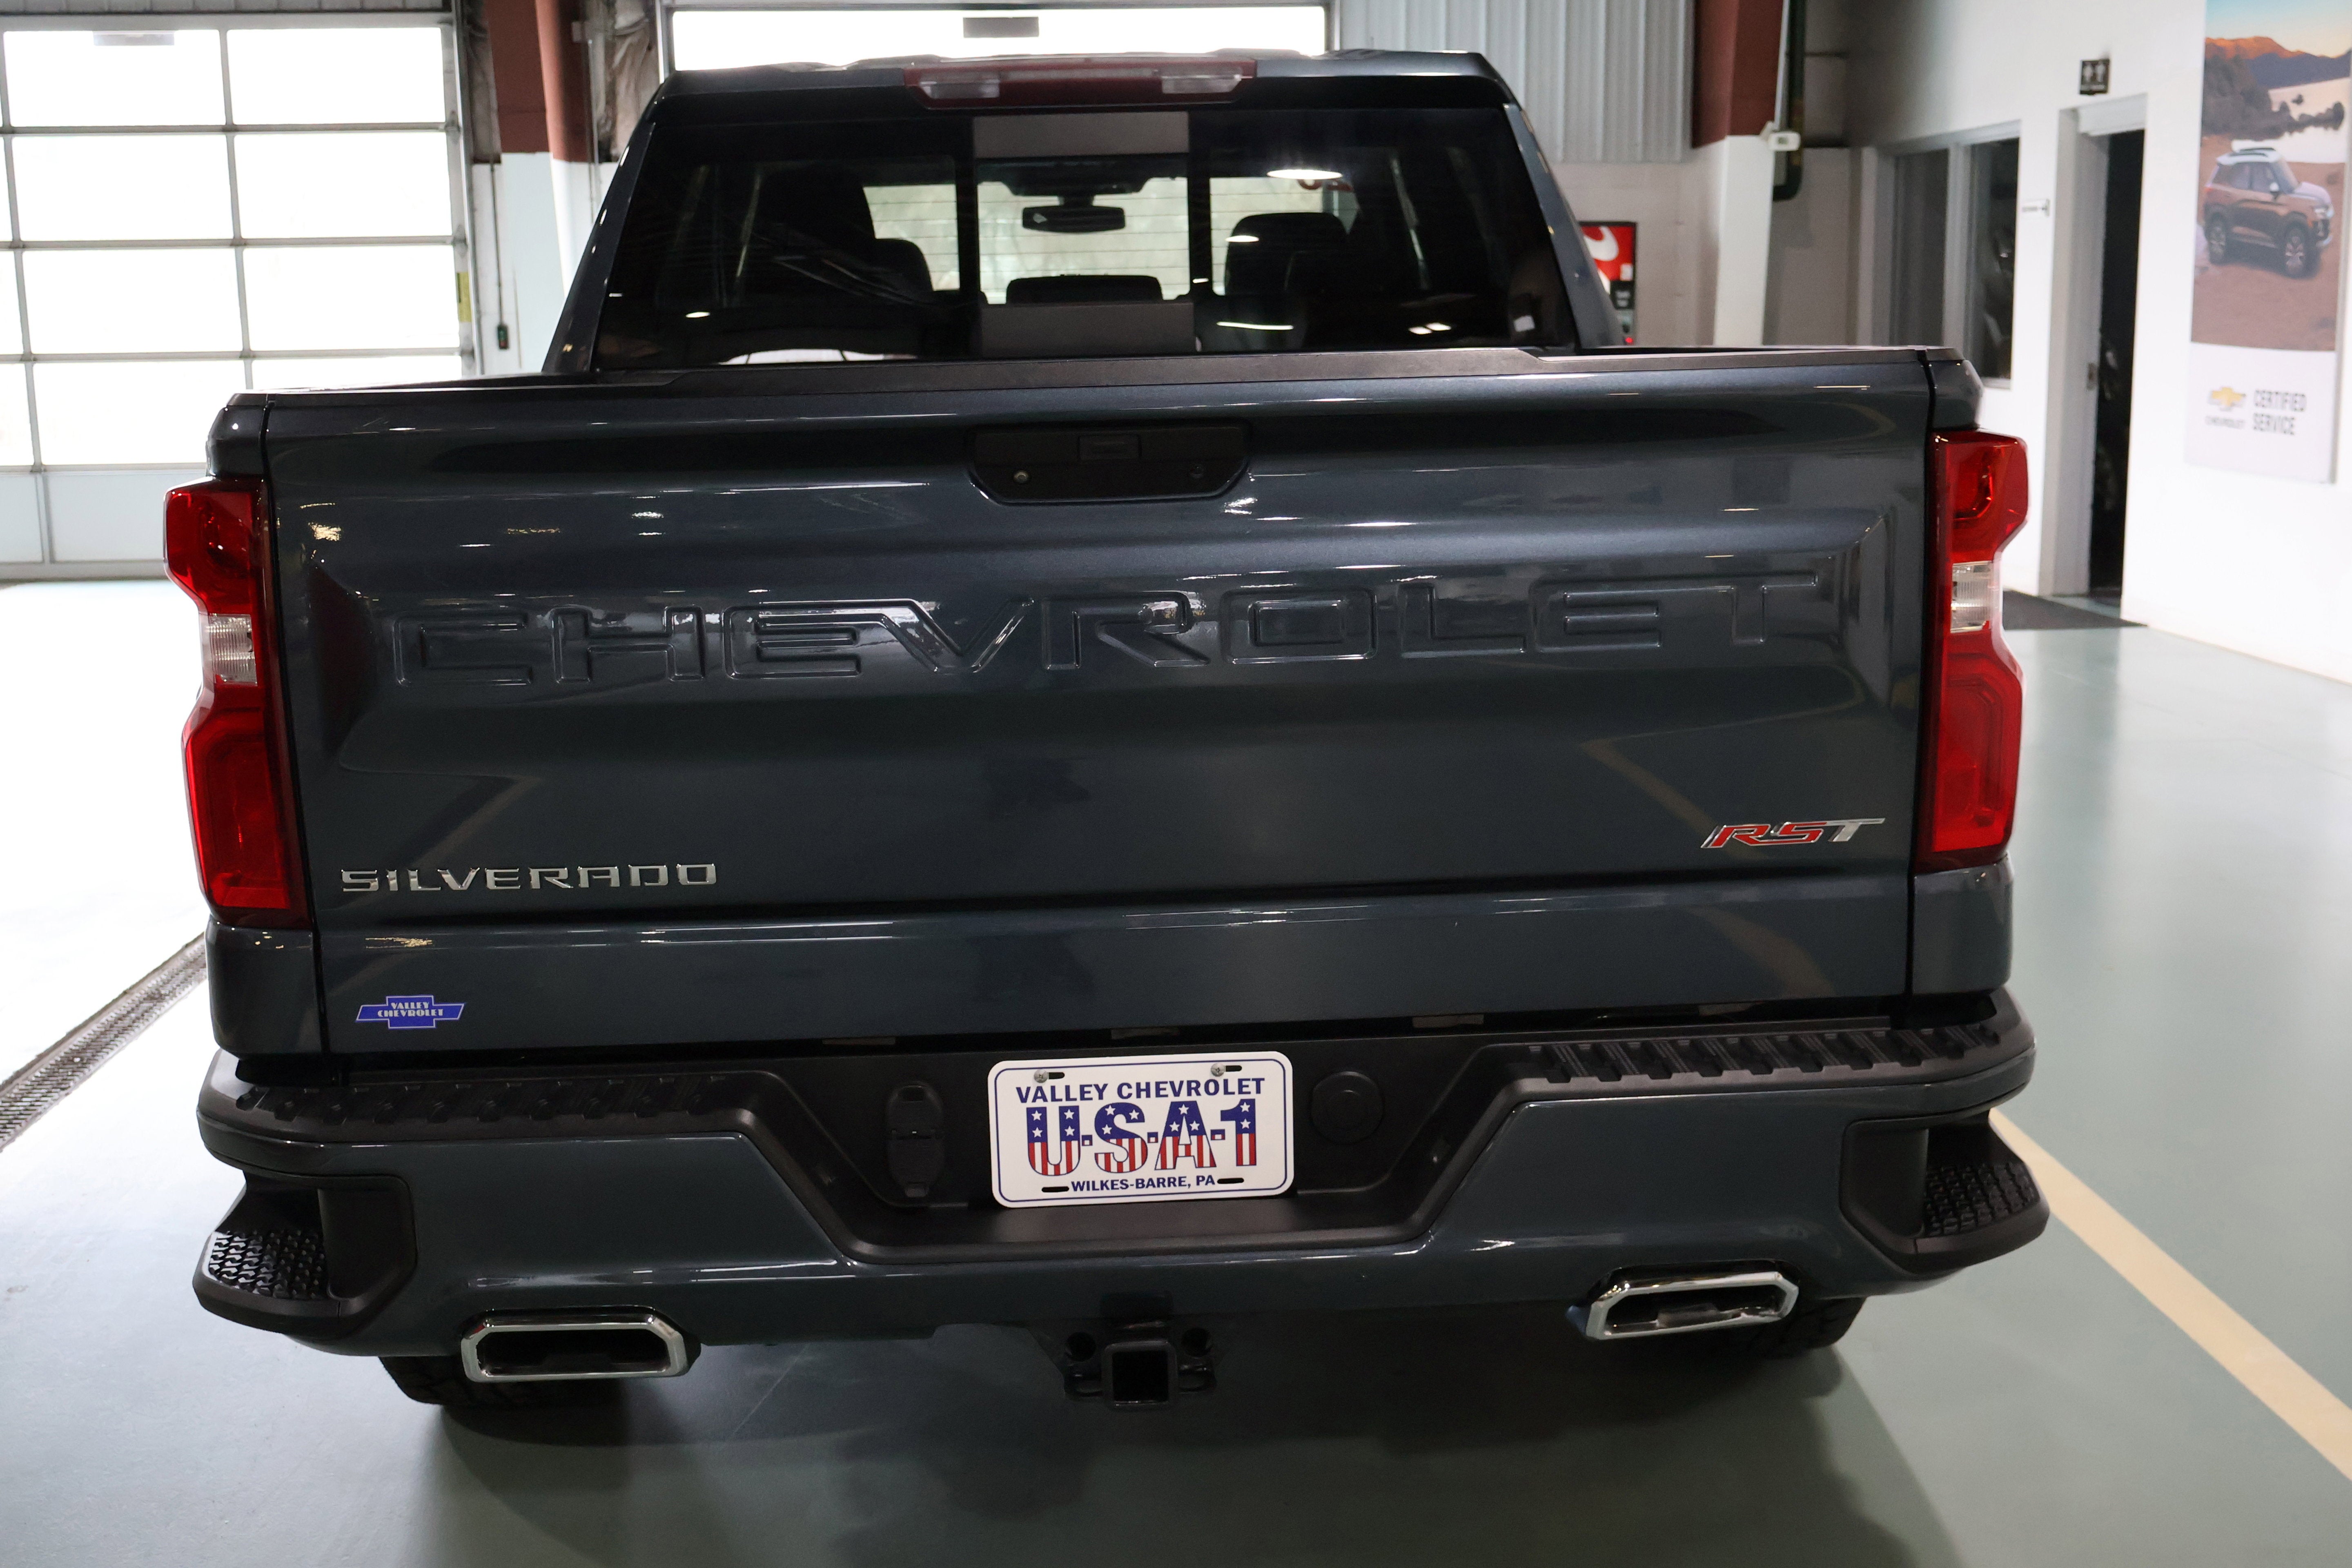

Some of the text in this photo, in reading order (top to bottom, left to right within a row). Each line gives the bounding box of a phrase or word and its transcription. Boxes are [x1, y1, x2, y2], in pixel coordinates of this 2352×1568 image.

[394, 571, 1819, 687] CHEVROLET
[1700, 817, 1886, 849] RST
[341, 863, 717, 892] SILVERADO
[377, 1009, 444, 1018] CHEVROLET
[390, 1001, 429, 1009] VALLEY
[1016, 1077, 1265, 1103] VALLEY CHEVROLET
[1071, 1174, 1216, 1192] WILKES-BARRE, PA
